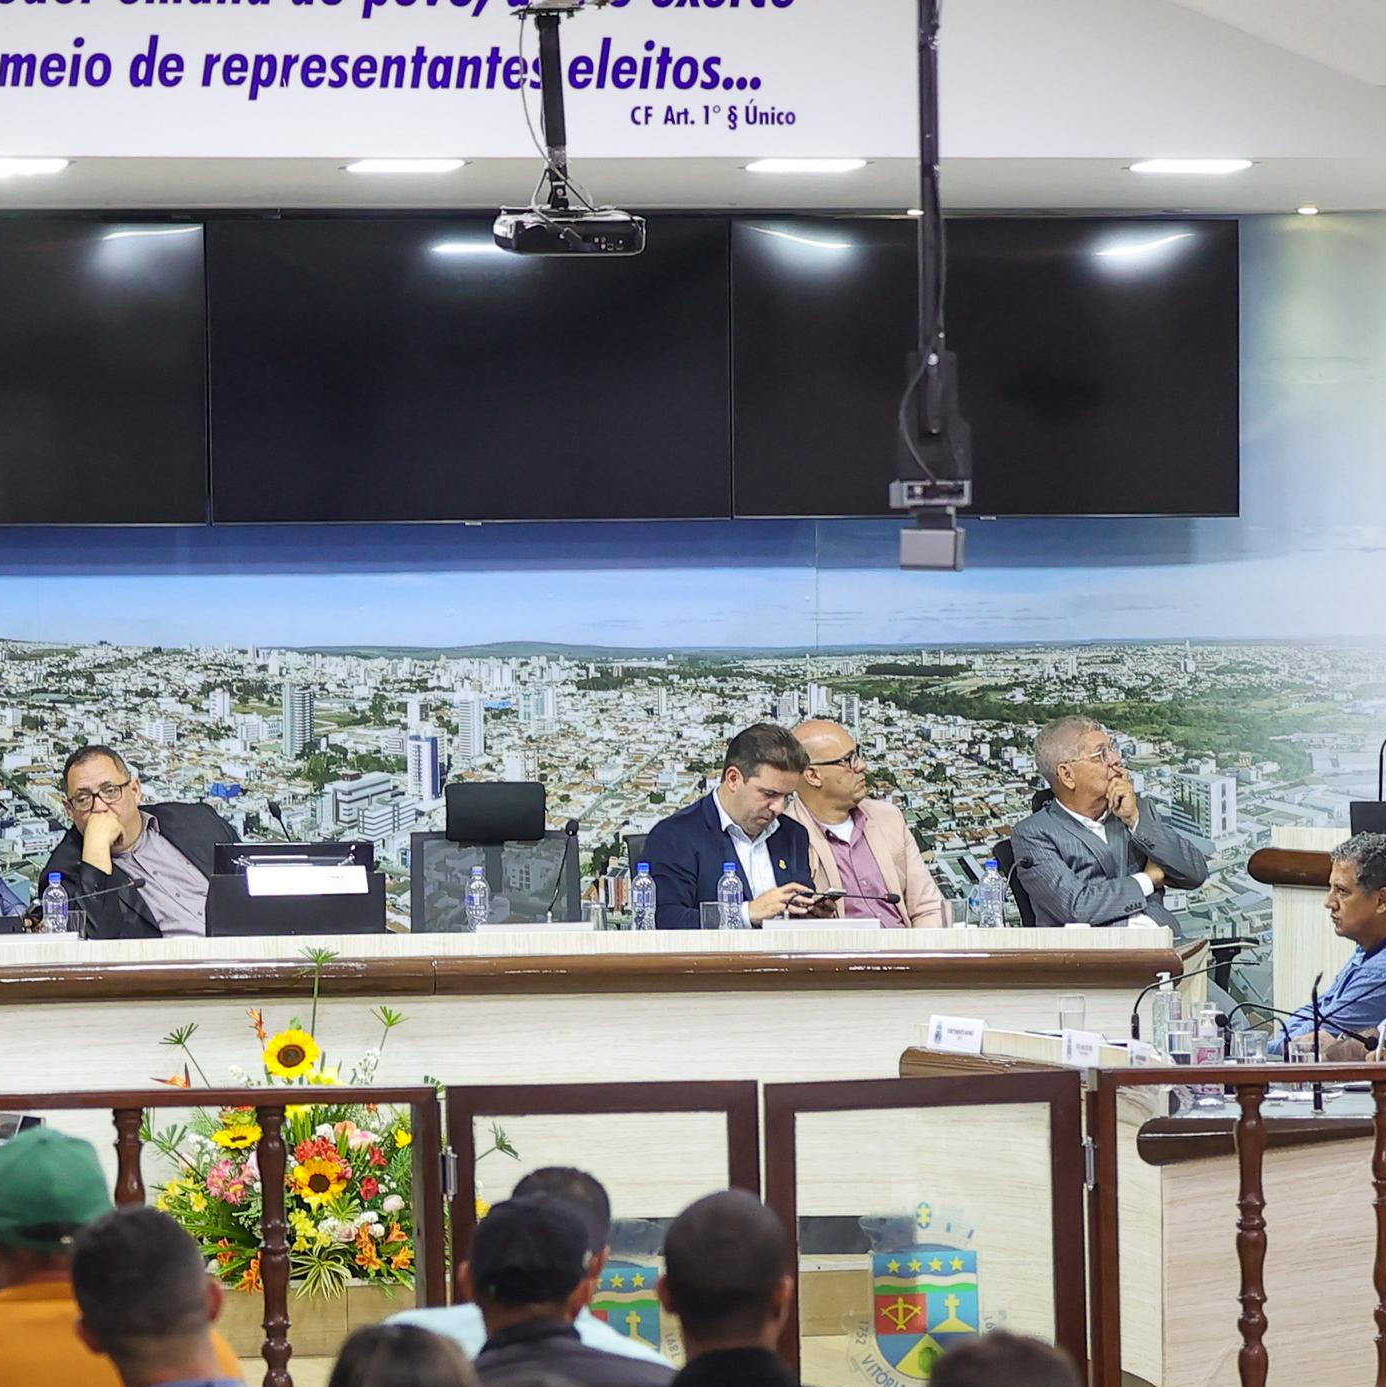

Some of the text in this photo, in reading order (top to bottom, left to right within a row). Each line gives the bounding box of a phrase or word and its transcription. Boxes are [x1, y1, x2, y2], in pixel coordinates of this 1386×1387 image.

[129, 34, 185, 88] de
[201, 46, 545, 101] representantes
[567, 37, 762, 90] eleitos...
[630, 106, 653, 125] CF
[663, 106, 696, 125] Art.
[744, 99, 796, 126] Único
[855, 1320, 869, 1345] 1752
